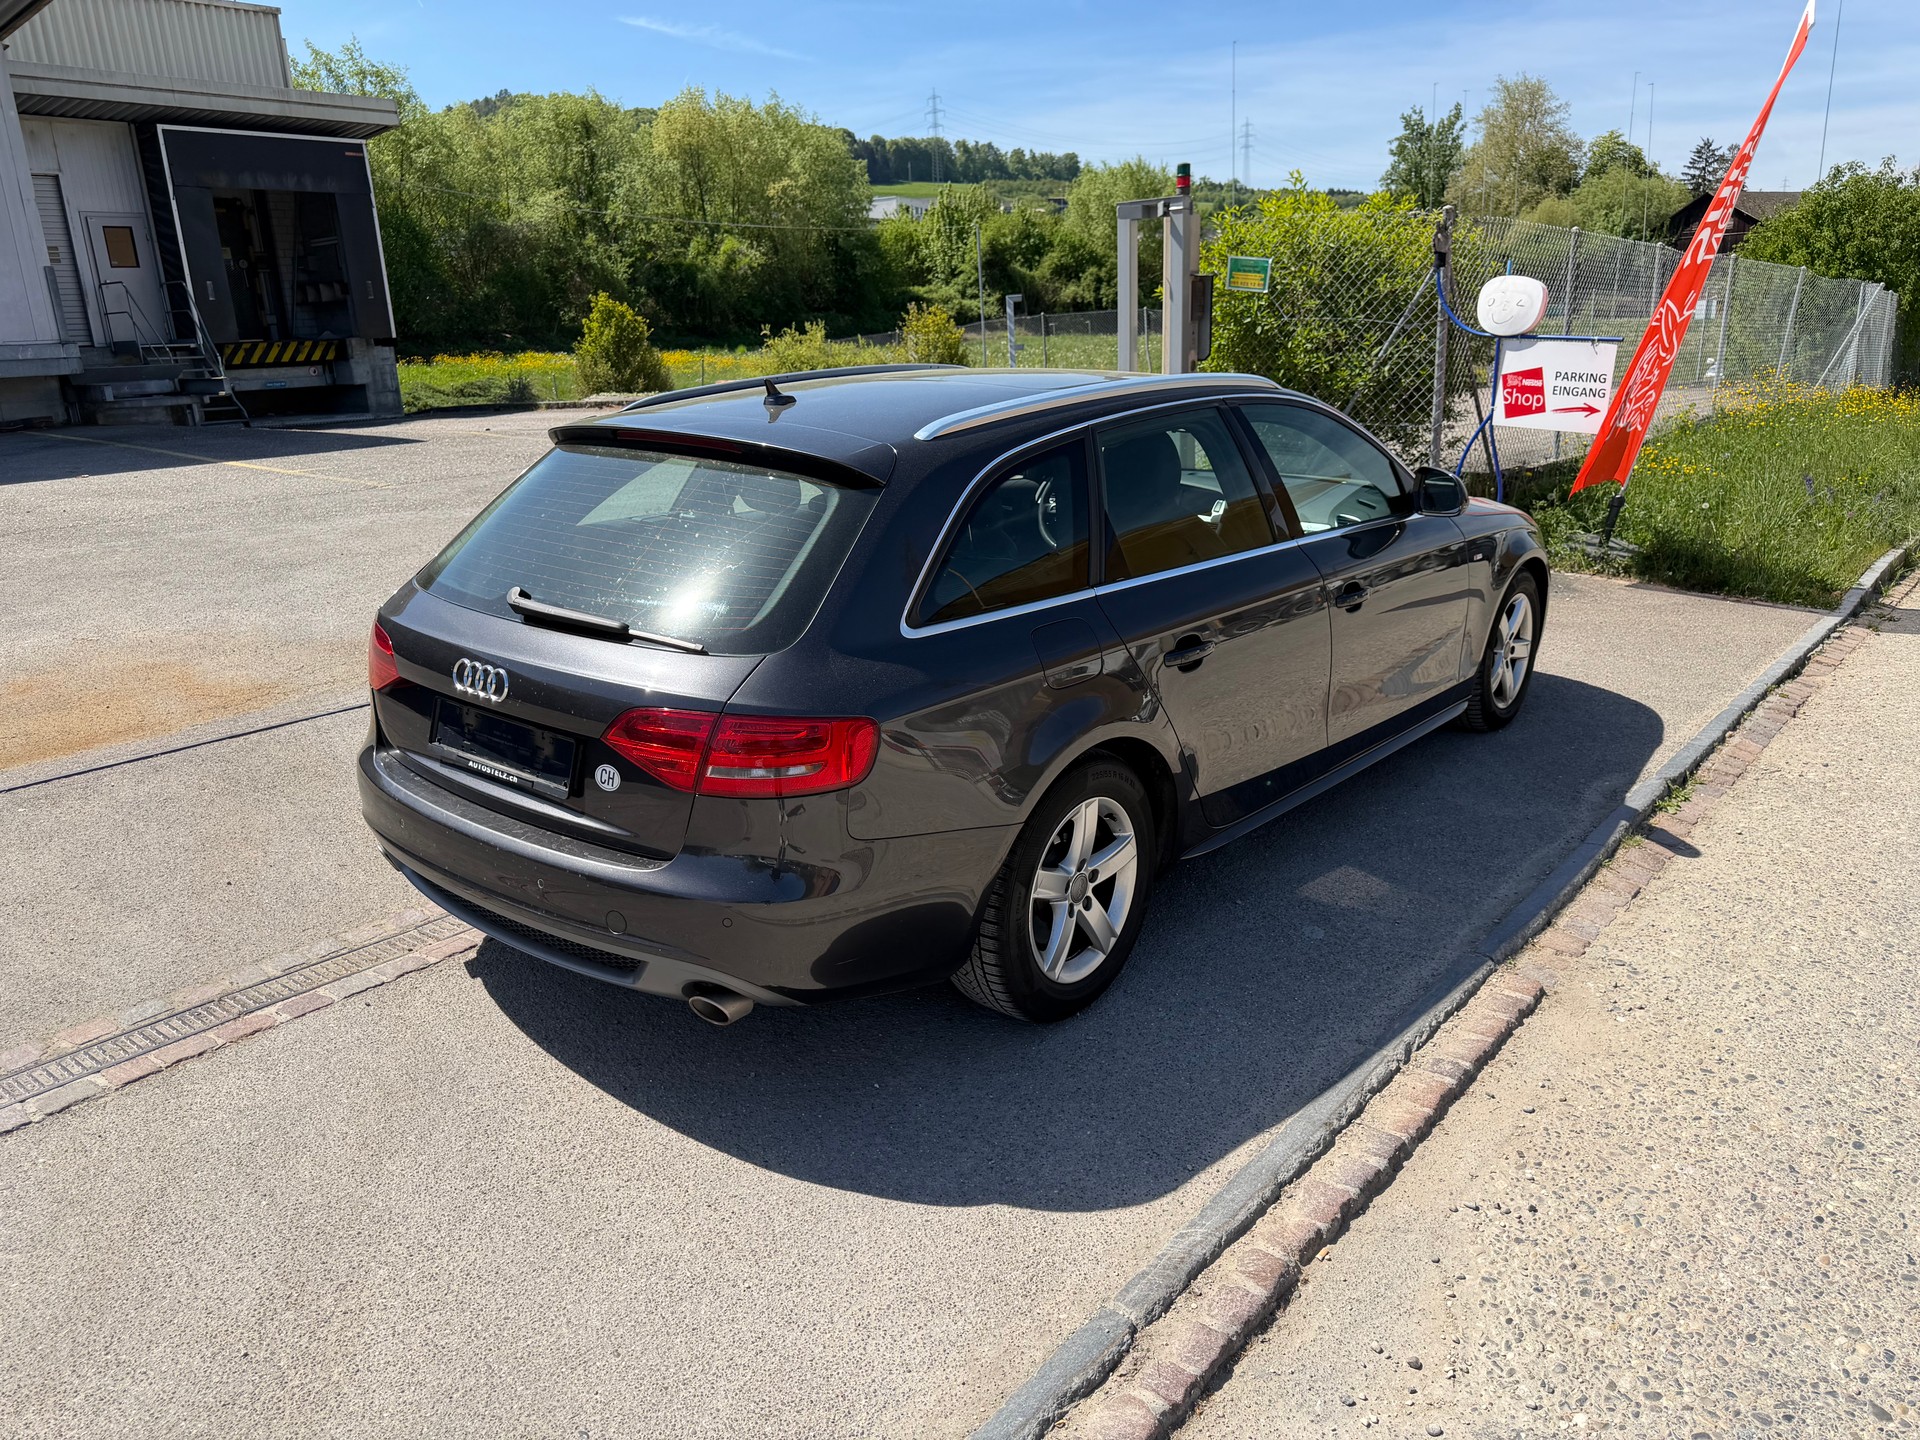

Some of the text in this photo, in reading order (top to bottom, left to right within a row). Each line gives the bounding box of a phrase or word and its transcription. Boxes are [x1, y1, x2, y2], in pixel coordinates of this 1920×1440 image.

[1555, 371, 1608, 384] PARKING
[1503, 388, 1543, 411] Shop
[1552, 385, 1607, 399] EINGANG
[468, 760, 518, 784] AUTOSTELZ.ch
[599, 768, 615, 788] CH
